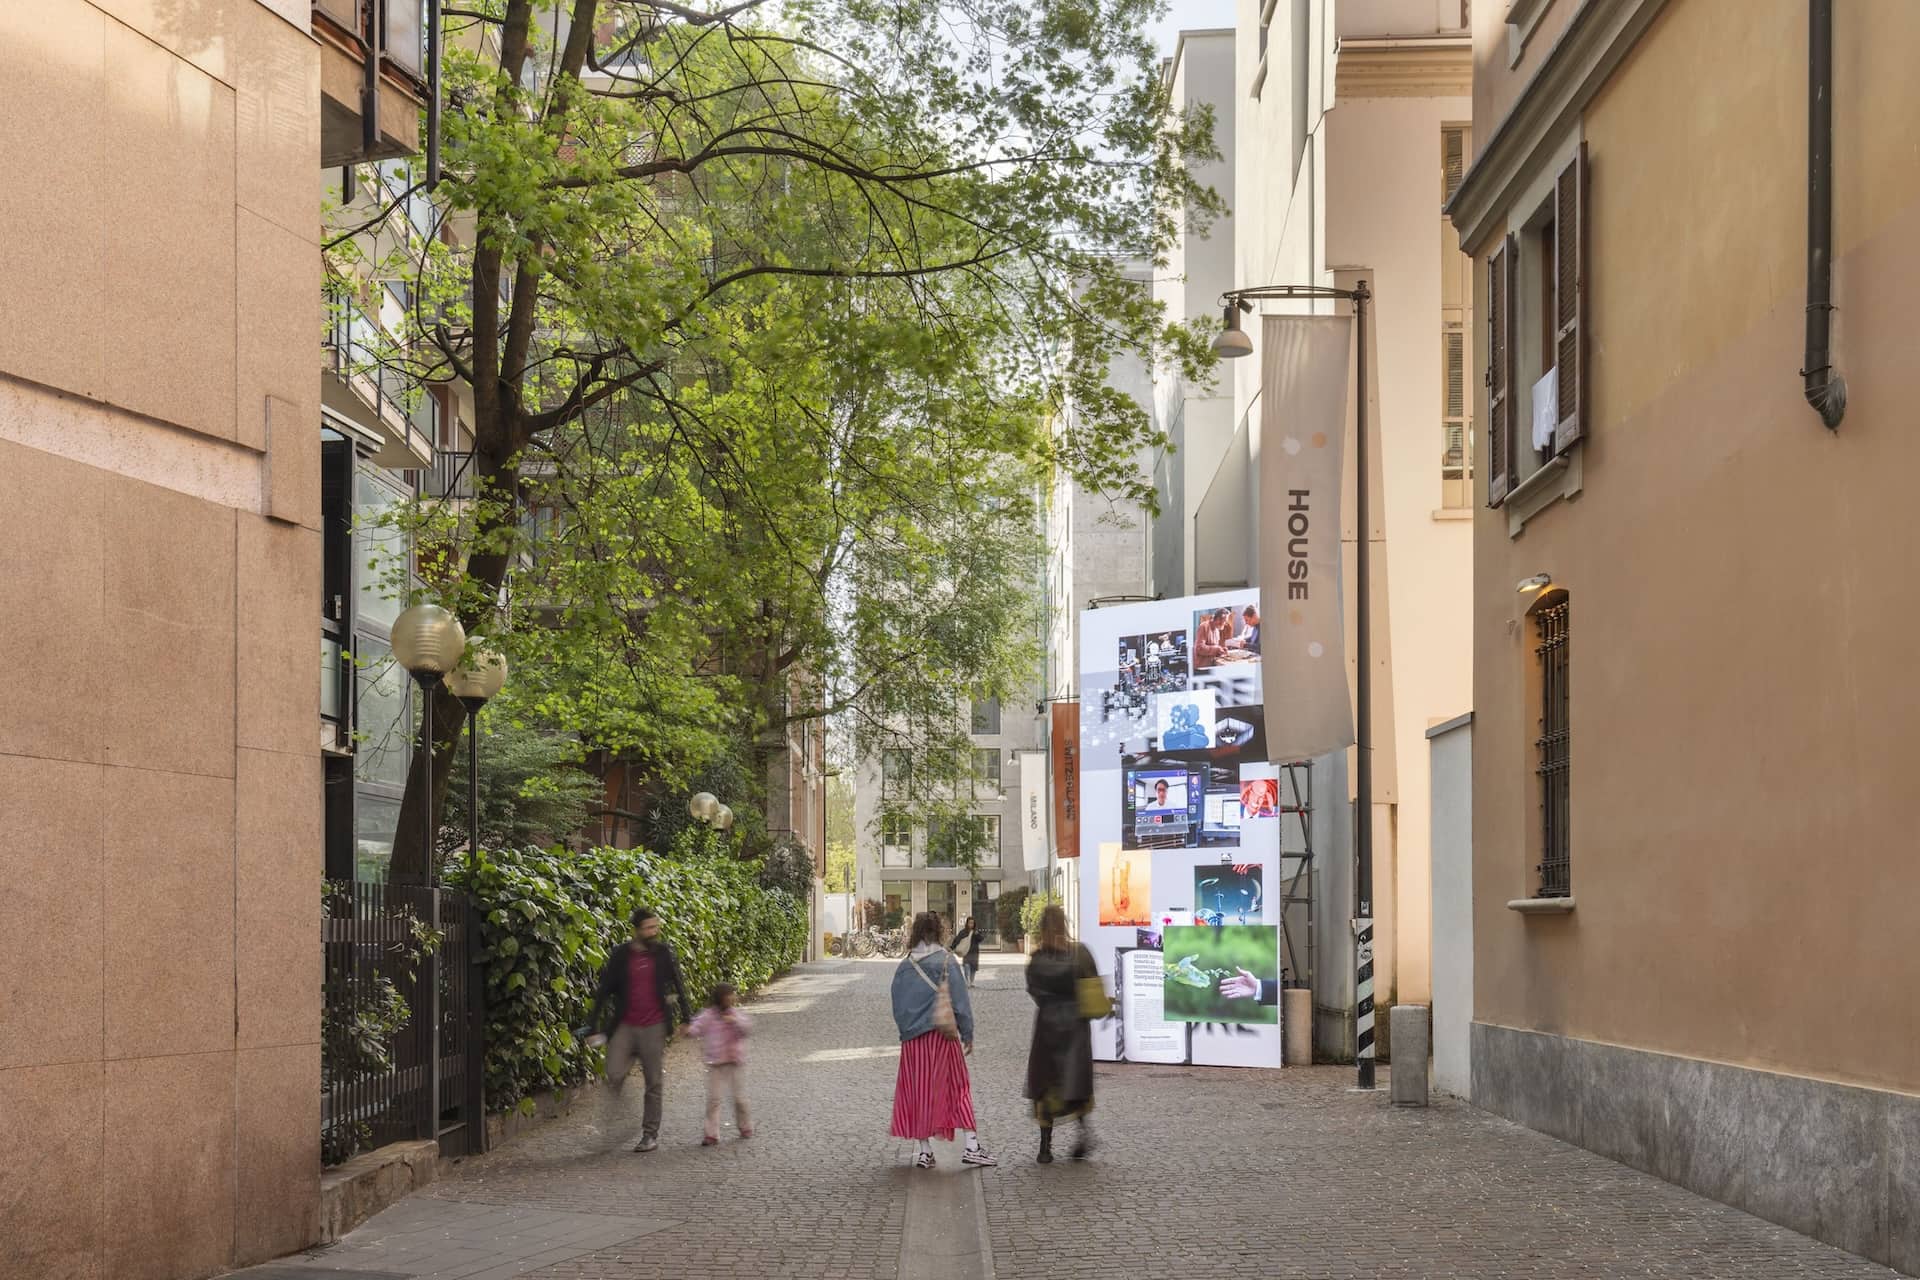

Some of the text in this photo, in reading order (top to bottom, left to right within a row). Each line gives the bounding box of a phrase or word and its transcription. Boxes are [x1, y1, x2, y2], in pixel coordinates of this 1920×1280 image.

[1288, 489, 1310, 600] HOUSE
[1030, 795, 1038, 830] MILANO
[1063, 739, 1076, 822] SWITZERLAND
